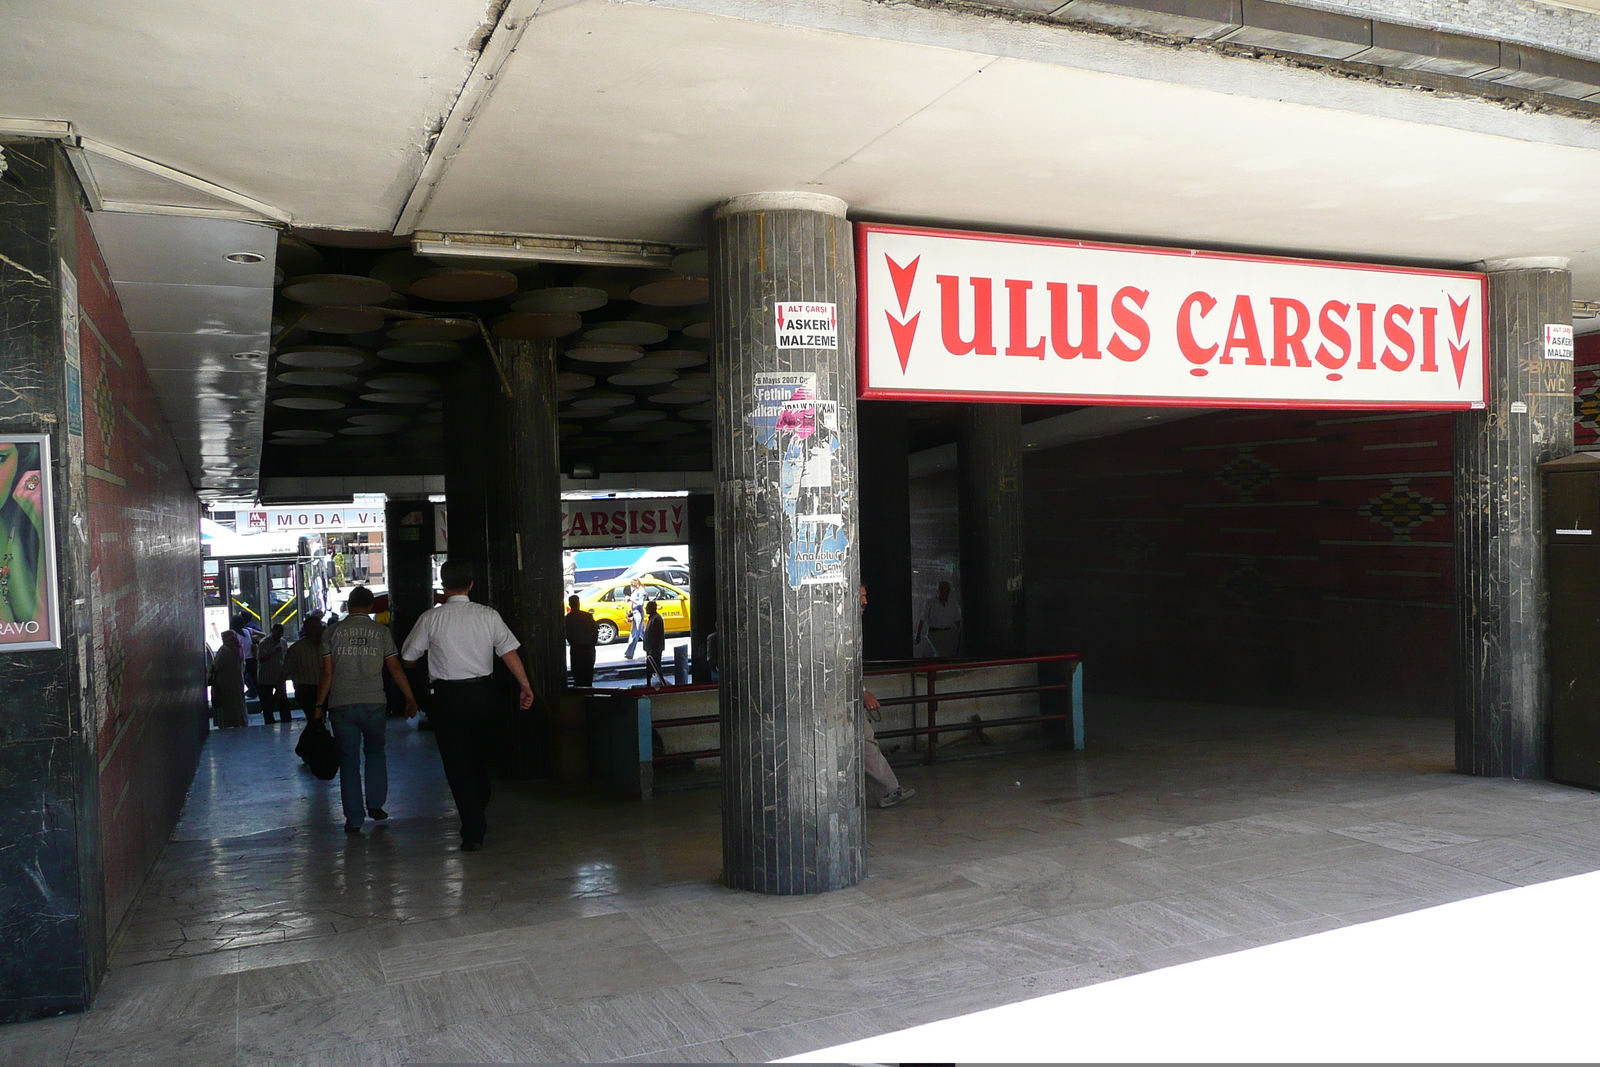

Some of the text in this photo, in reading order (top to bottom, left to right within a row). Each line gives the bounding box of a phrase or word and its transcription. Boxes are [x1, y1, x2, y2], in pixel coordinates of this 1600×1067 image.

[788, 305, 827, 314] ALT ÇARŞI
[786, 317, 830, 331] ASKERİ
[936, 274, 1439, 382] ULUS ÇARŞISI
[780, 335, 836, 347] MALZEME
[782, 376, 798, 384] 2007
[1544, 378, 1566, 392] WC
[758, 387, 792, 401] Fethin
[276, 512, 343, 526] MODA
[795, 550, 834, 561] Anaolu
[336, 627, 381, 640] MARITIME
